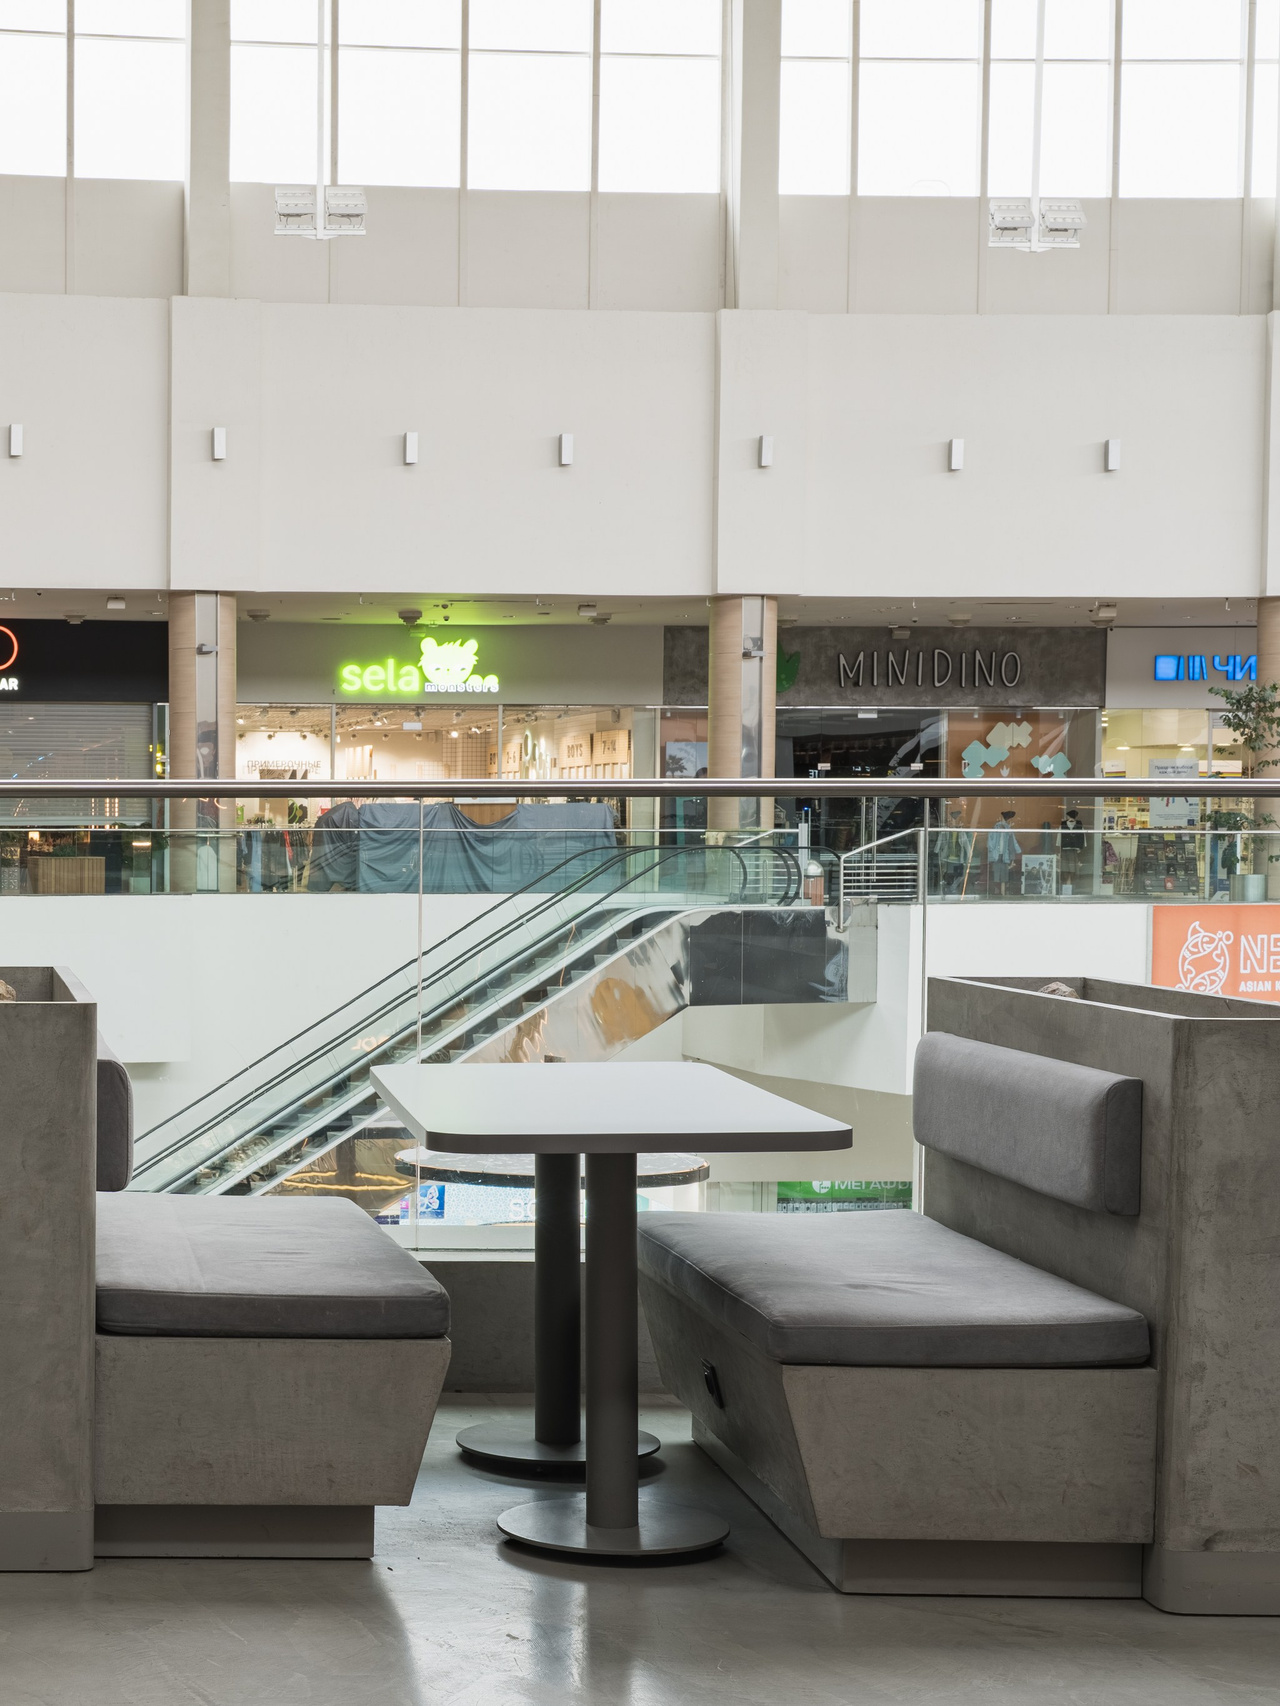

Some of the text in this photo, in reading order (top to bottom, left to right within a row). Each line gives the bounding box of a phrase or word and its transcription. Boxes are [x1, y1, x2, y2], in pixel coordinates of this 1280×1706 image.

[341, 658, 420, 692] sela
[839, 649, 1020, 688] MINIDINO
[424, 681, 500, 693] monsters
[567, 743, 583, 758] BOYS
[246, 760, 322, 768] ПРИМЕРОЧНЫЕ
[1239, 980, 1272, 992] ASIAN
